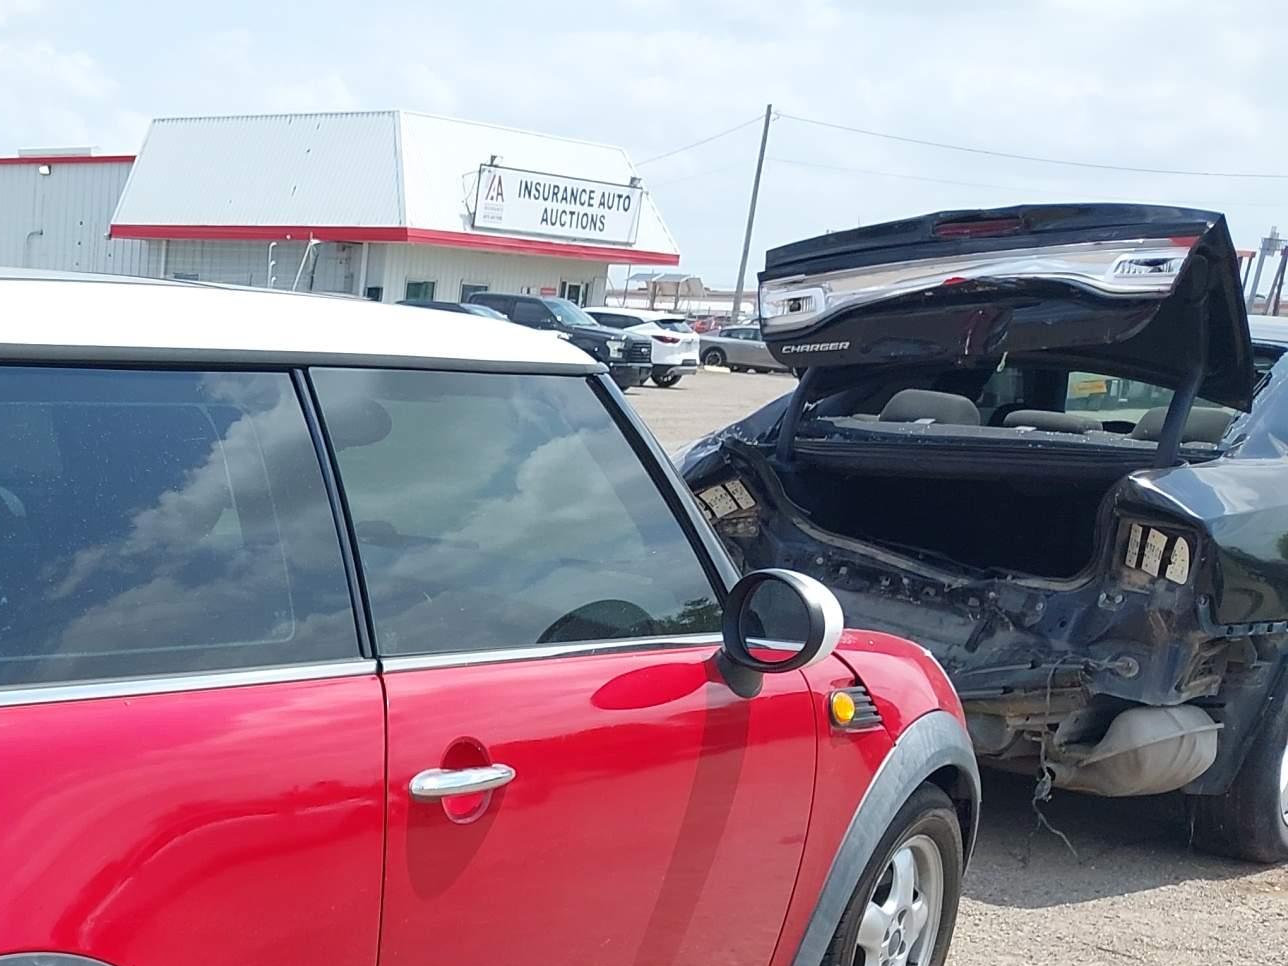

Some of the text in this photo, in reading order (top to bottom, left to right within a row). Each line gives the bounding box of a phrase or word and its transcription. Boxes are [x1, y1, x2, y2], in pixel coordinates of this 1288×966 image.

[517, 179, 631, 212] INSURANCE AUTO
[540, 207, 606, 232] AUCTIONS
[782, 341, 850, 353] CHARGER
